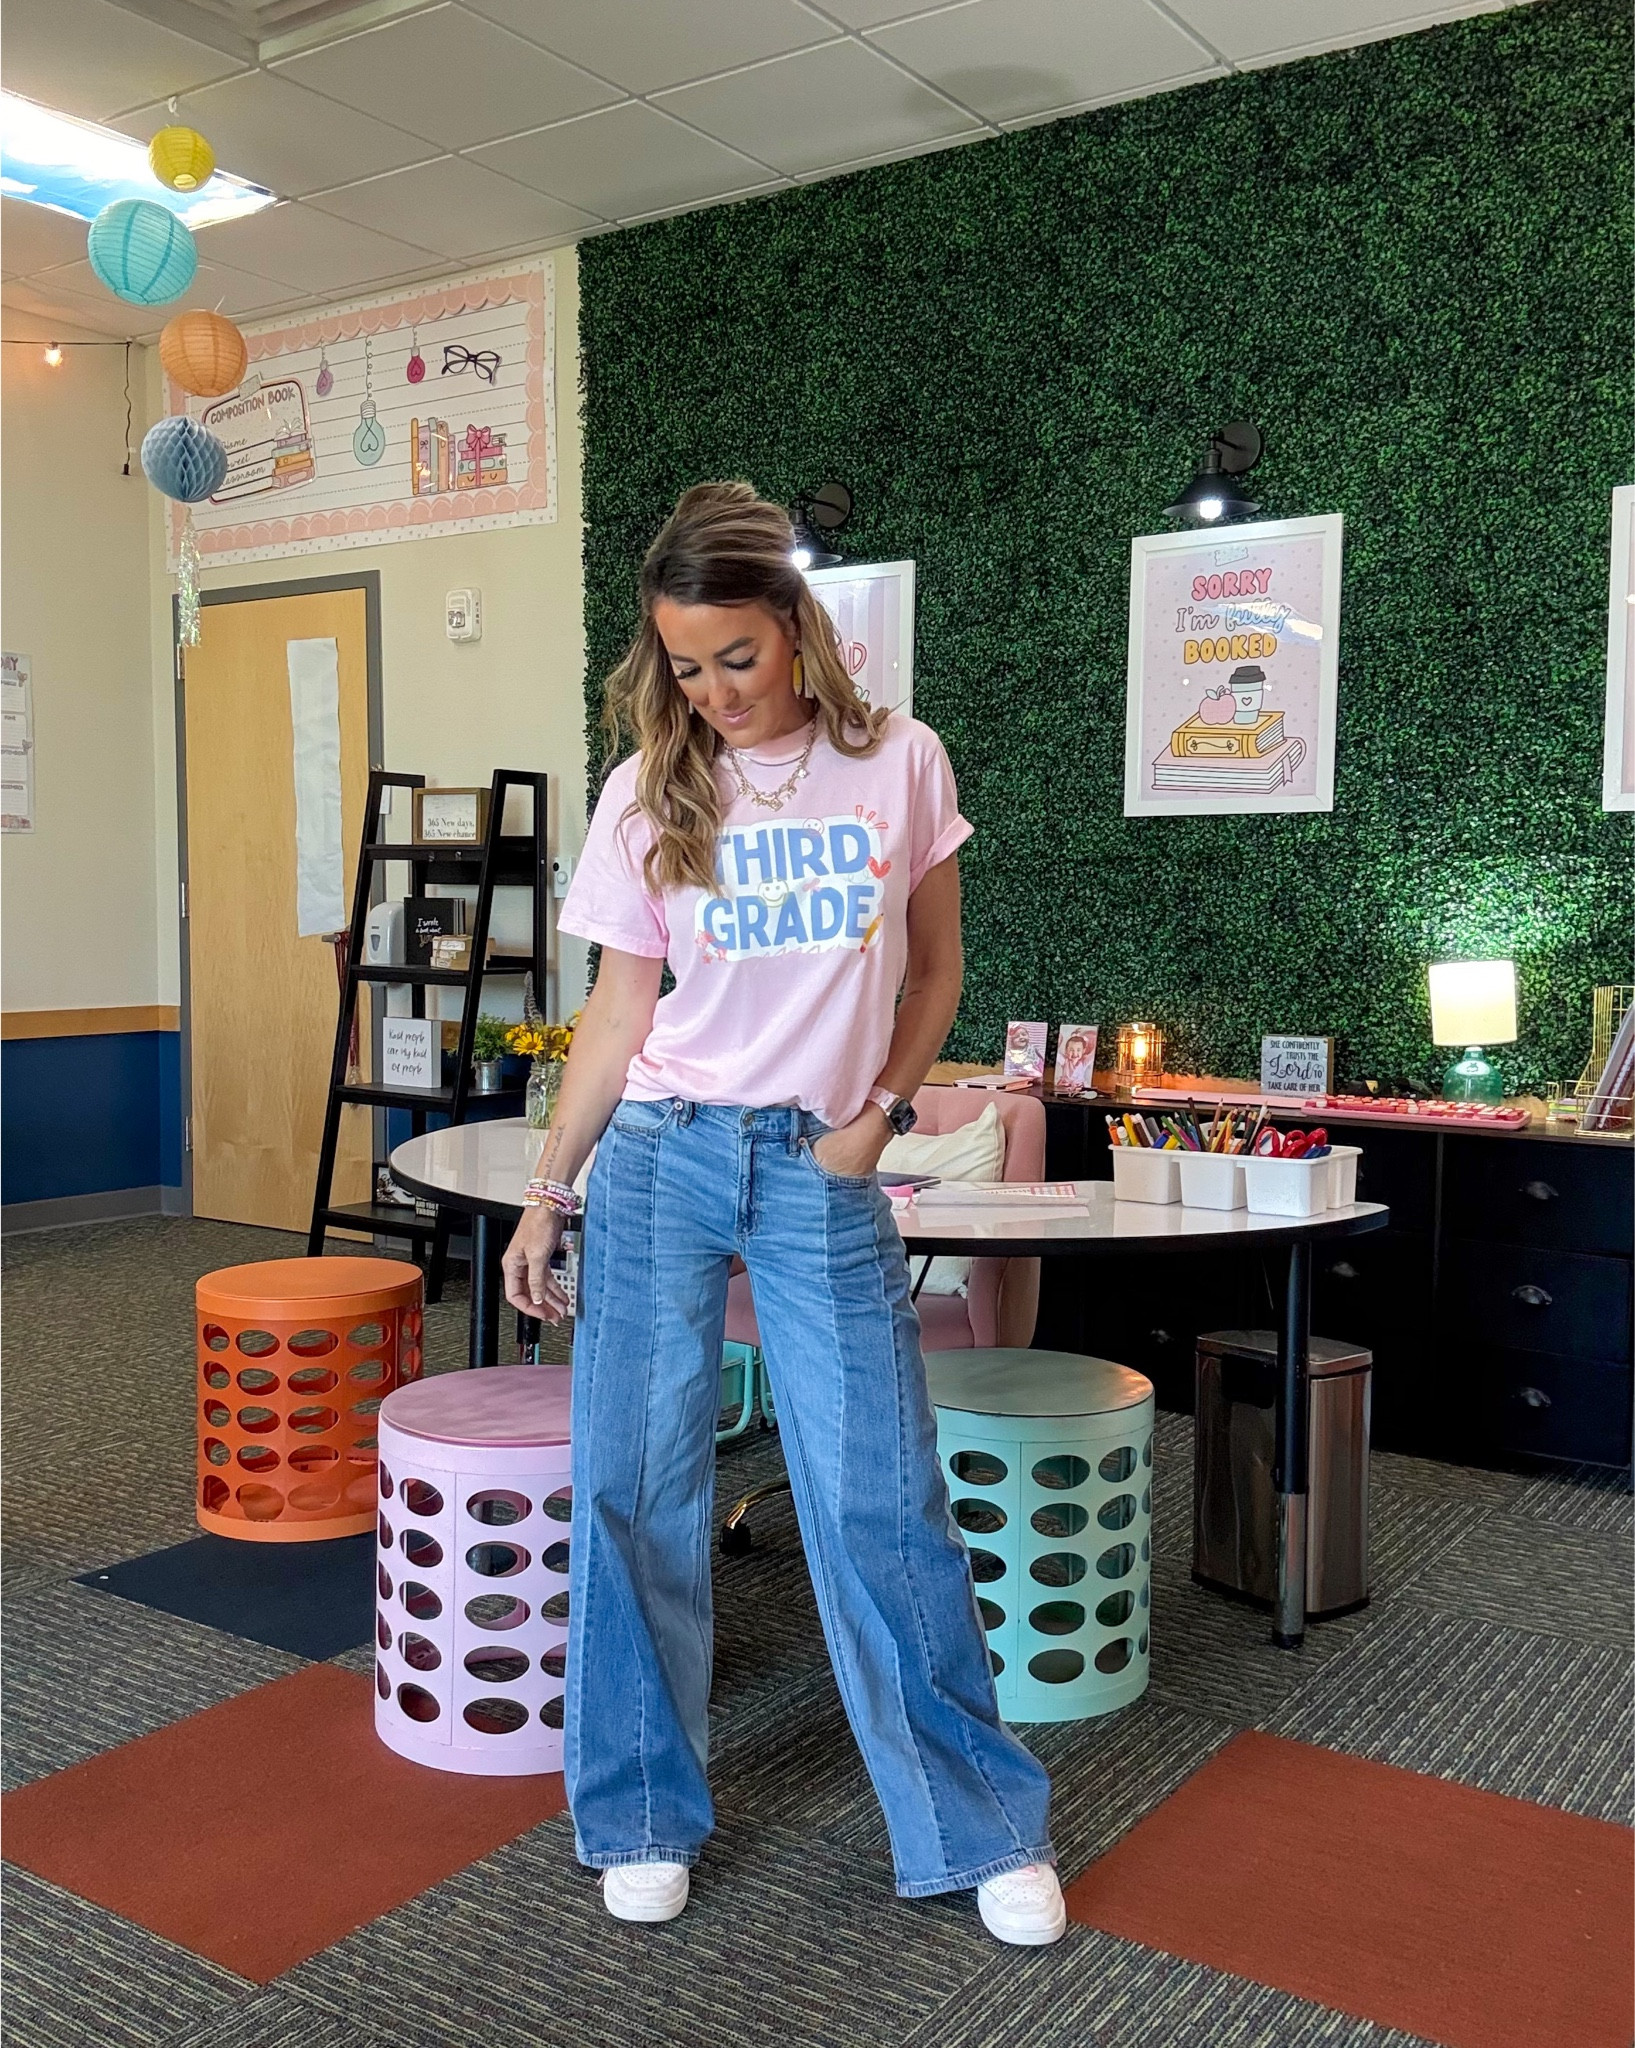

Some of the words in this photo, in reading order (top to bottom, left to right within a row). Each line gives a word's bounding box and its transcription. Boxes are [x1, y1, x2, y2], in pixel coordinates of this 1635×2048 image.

[211, 393, 265, 425] COMPOSITION
[267, 387, 296, 406] BOOK
[1191, 567, 1272, 601] SORRY
[1176, 607, 1219, 633] I'm
[1183, 633, 1277, 664] BOOKED
[437, 829, 451, 837] New
[441, 817, 455, 827] New
[714, 824, 871, 885] THIRD
[417, 918, 423, 927] I
[703, 885, 875, 950] GRADE
[1270, 1040, 1280, 1048] SHE
[1282, 1040, 1320, 1050] CONFIDENTLY
[1286, 1051, 1306, 1060] TRUSTS
[1308, 1052, 1319, 1061] THE
[1265, 1053, 1313, 1080] Lord
[1313, 1069, 1323, 1078] TO
[1268, 1081, 1282, 1091] TAKE
[1283, 1082, 1298, 1092] CARE
[1299, 1083, 1307, 1092] OF
[1308, 1083, 1320, 1093] HER
